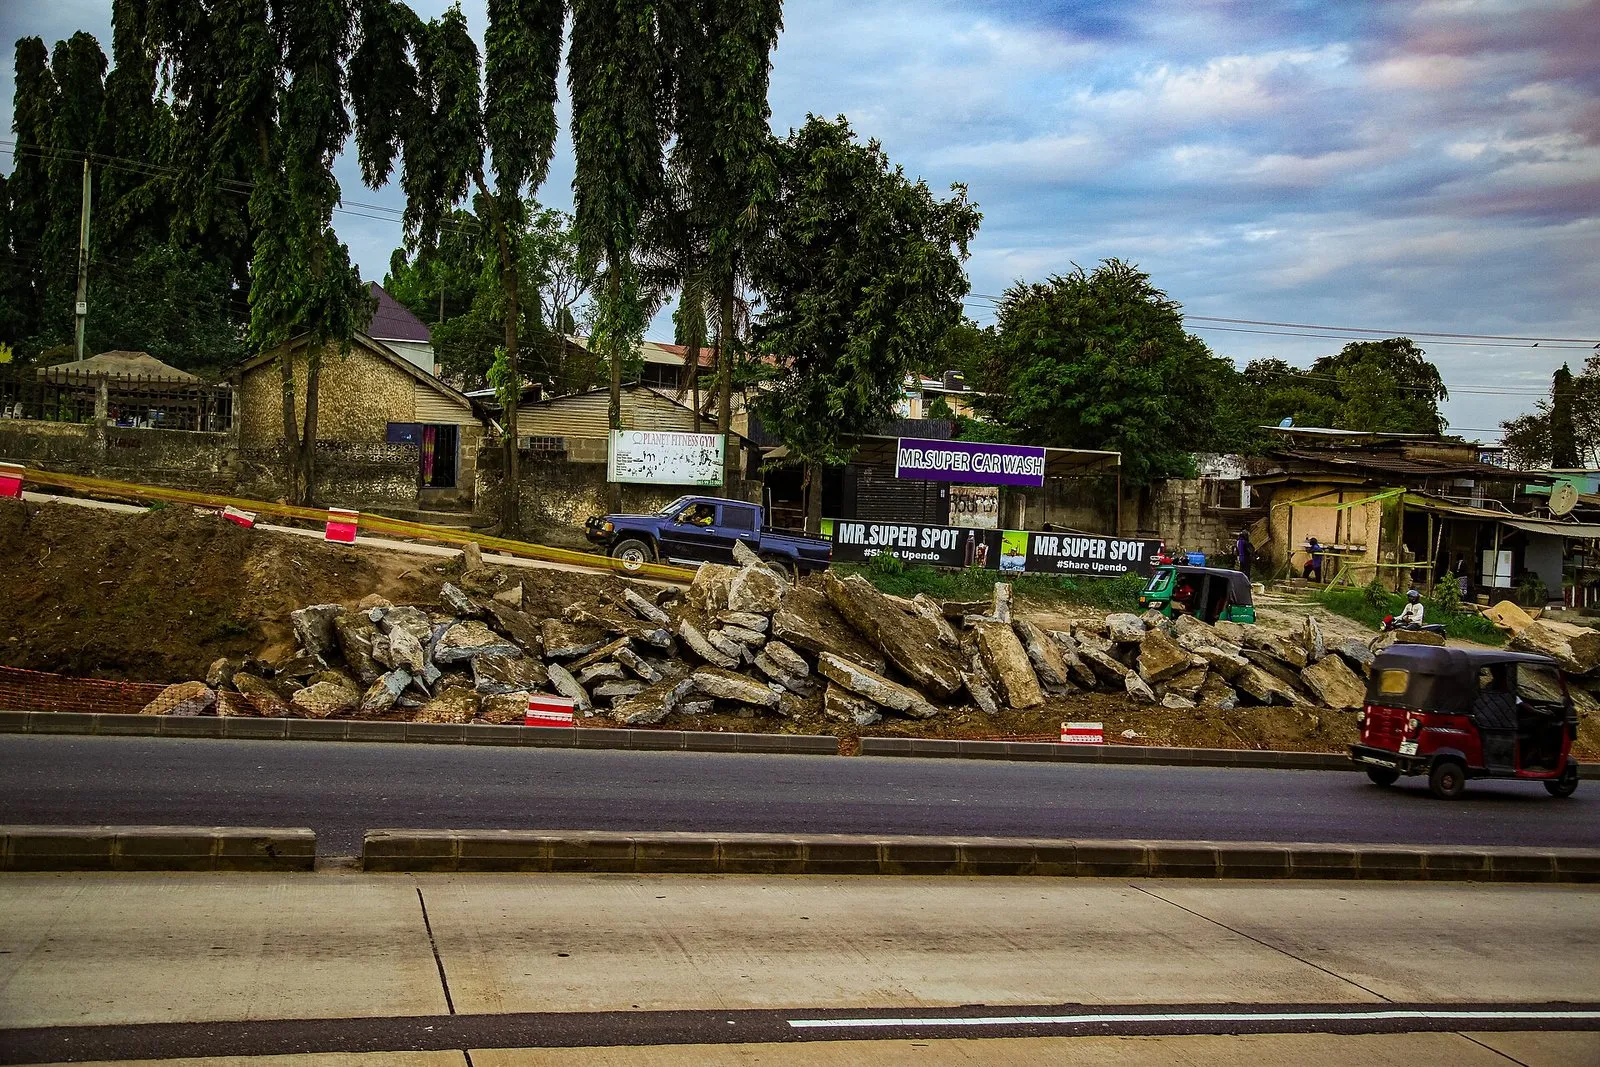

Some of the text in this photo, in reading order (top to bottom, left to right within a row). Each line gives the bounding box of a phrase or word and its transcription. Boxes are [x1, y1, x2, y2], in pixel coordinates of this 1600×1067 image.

[643, 432, 716, 448] PLANET FITNESS GYM
[899, 448, 1044, 476] MR.SUPER CAR WASH
[838, 523, 960, 550] MR.SUPER SPOT
[901, 550, 940, 561] Upendo
[1033, 535, 1145, 562] MR.SUPER SPOT
[1056, 560, 1128, 572] #Share Upendo
